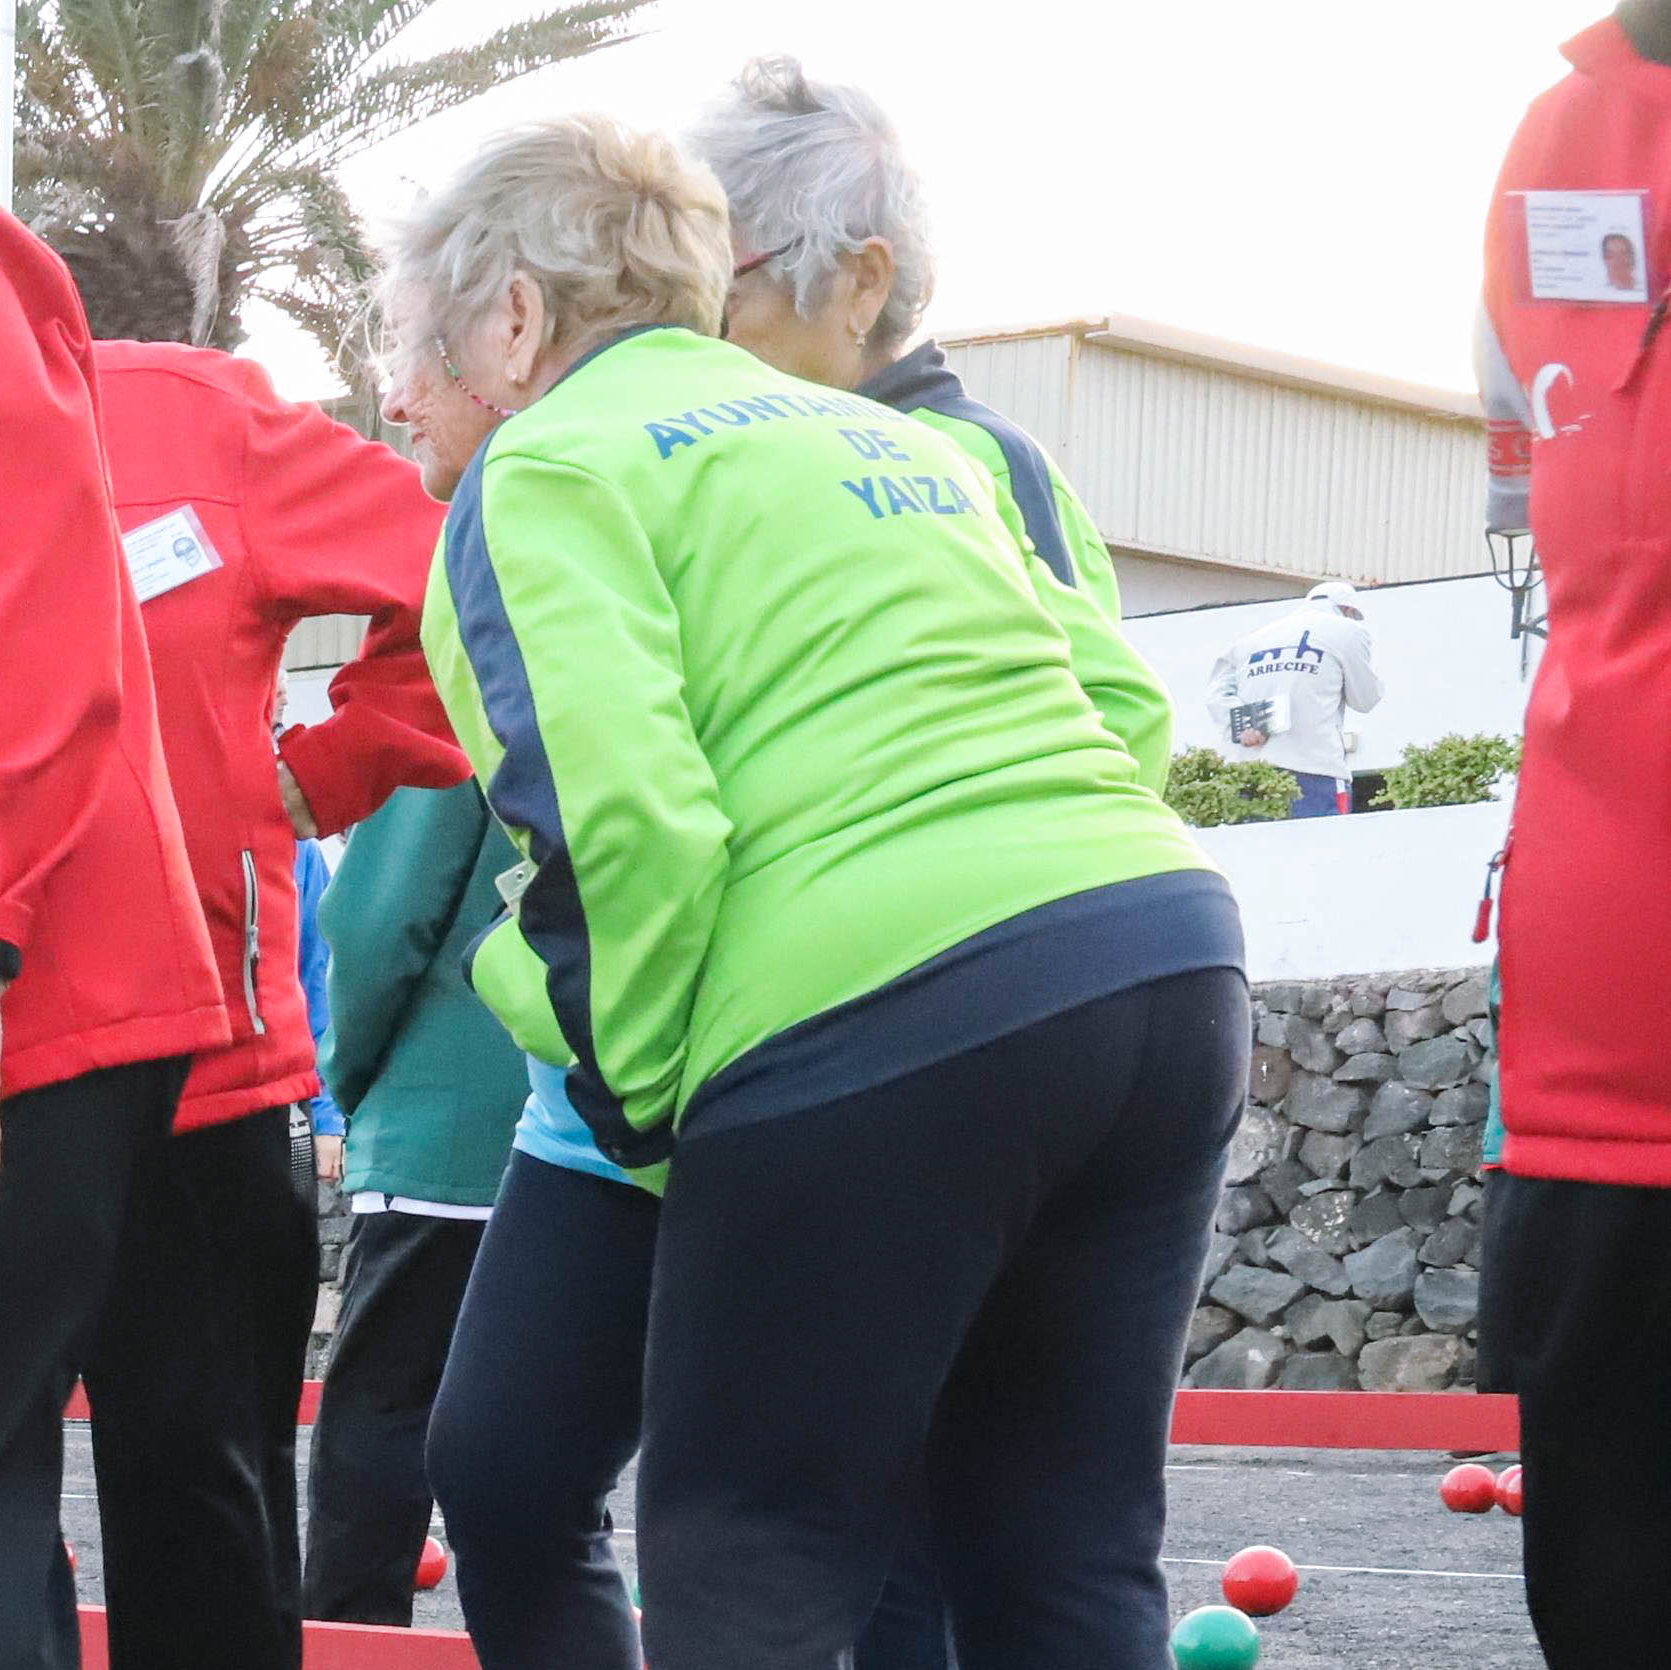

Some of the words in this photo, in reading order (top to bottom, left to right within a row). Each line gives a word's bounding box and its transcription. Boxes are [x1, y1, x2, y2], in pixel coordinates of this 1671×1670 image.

[838, 428, 912, 462] DE
[840, 475, 981, 519] YAIZA
[1247, 661, 1320, 679] ARRECIFE
